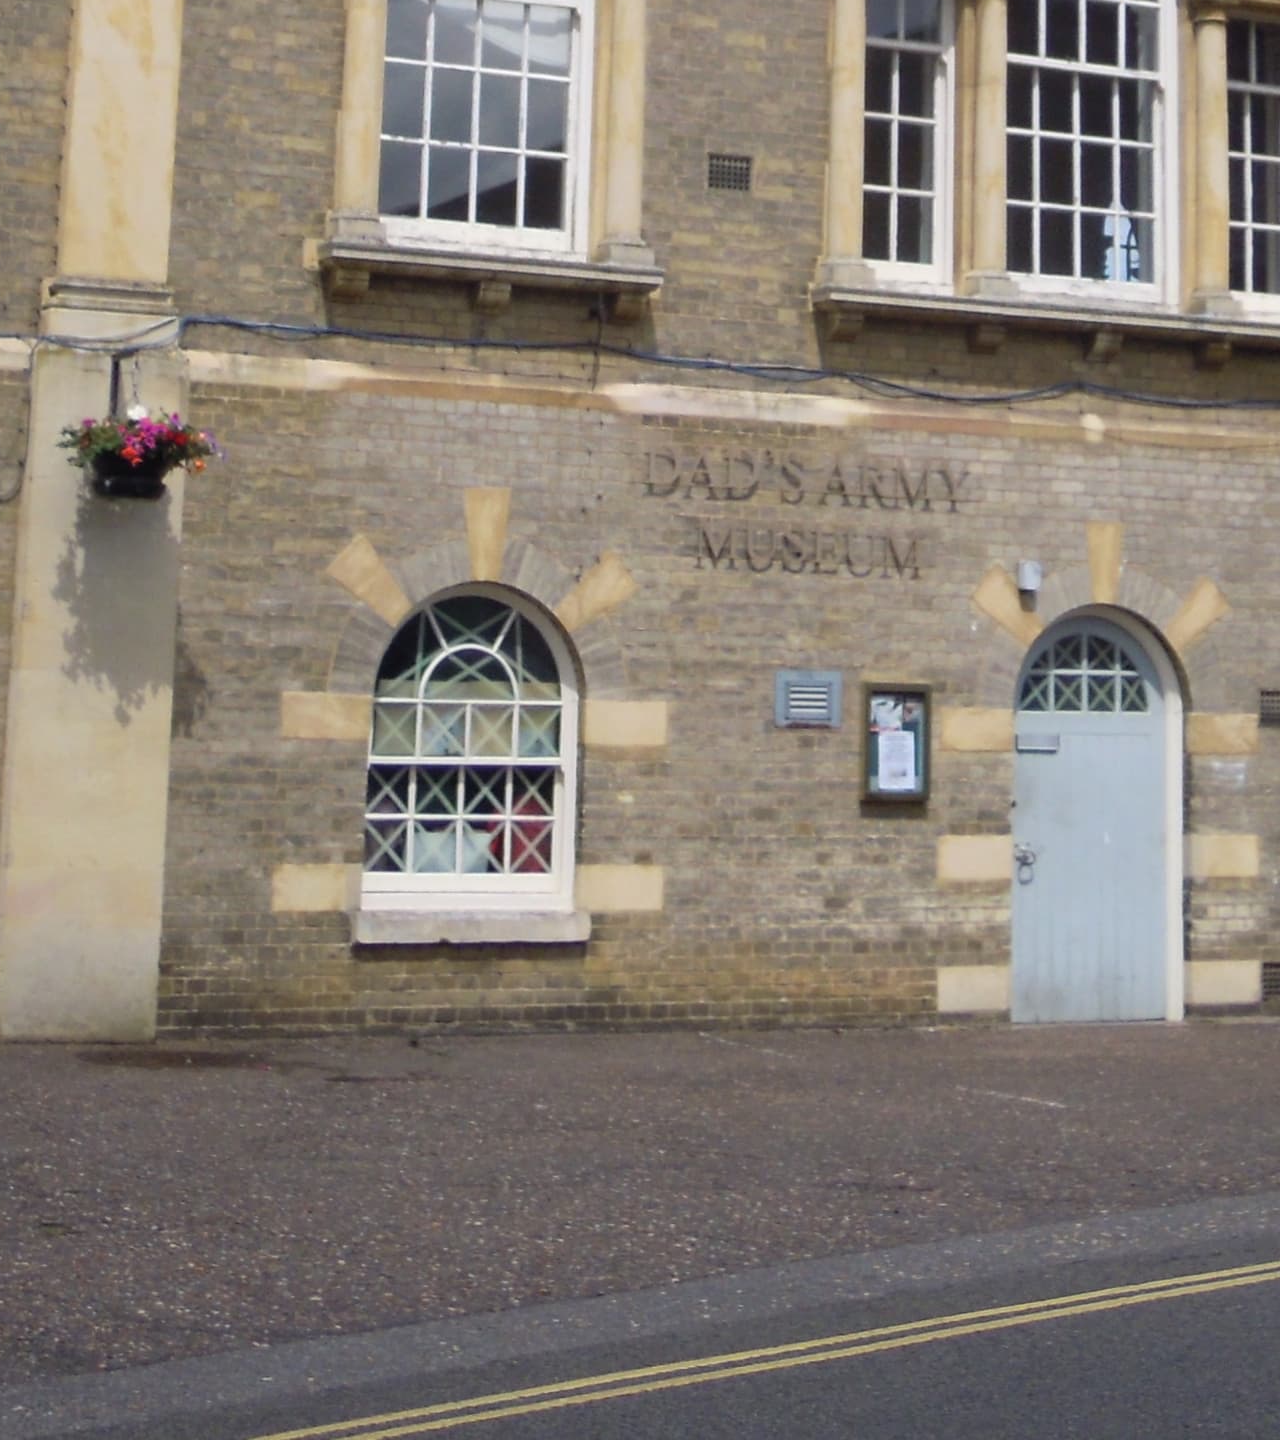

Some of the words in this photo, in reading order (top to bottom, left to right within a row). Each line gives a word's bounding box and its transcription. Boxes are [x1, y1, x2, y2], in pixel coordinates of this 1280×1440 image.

[642, 447, 804, 505] DAD'S
[821, 463, 972, 513] ARMY
[693, 526, 922, 580] MUSEUM
